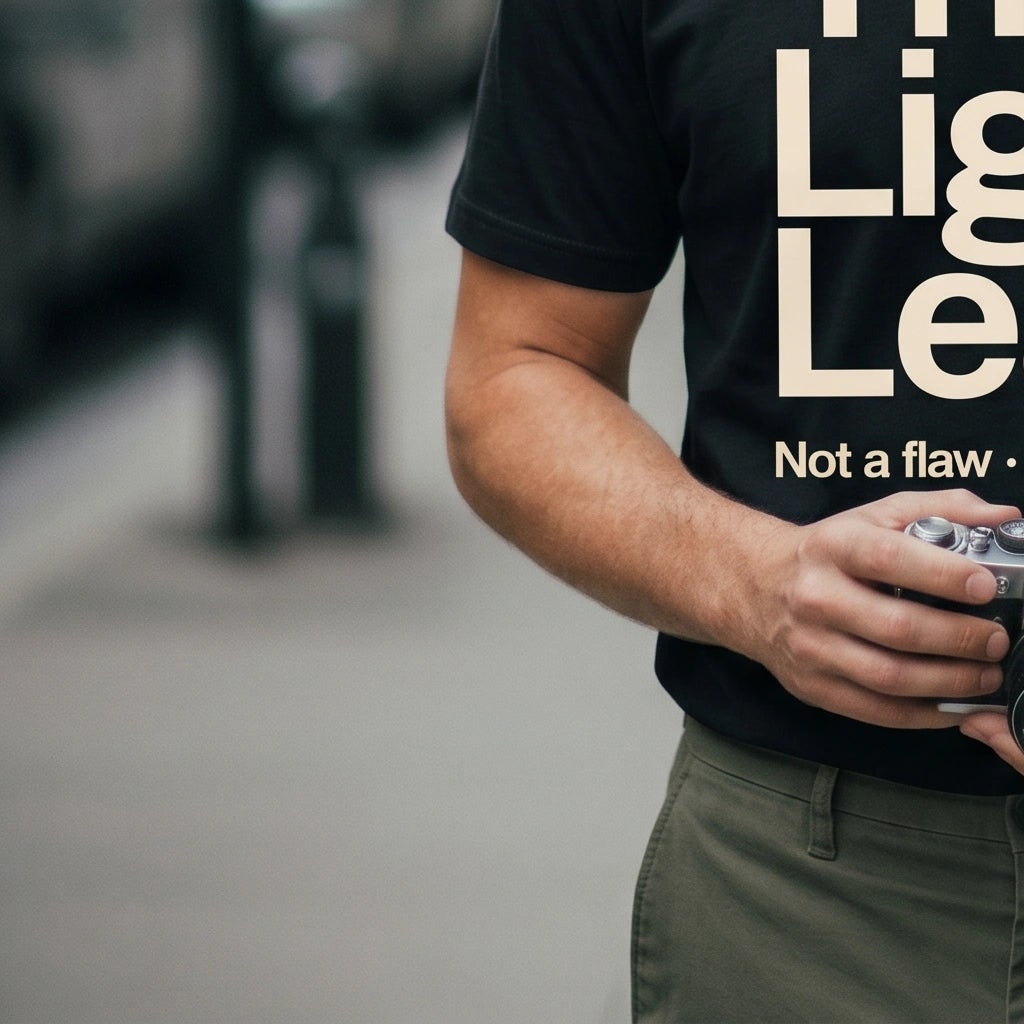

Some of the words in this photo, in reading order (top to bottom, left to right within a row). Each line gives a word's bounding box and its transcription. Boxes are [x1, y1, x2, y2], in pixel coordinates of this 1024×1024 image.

[775, 440, 852, 479] Not
[863, 450, 891, 479] a
[901, 439, 994, 479] flaw
